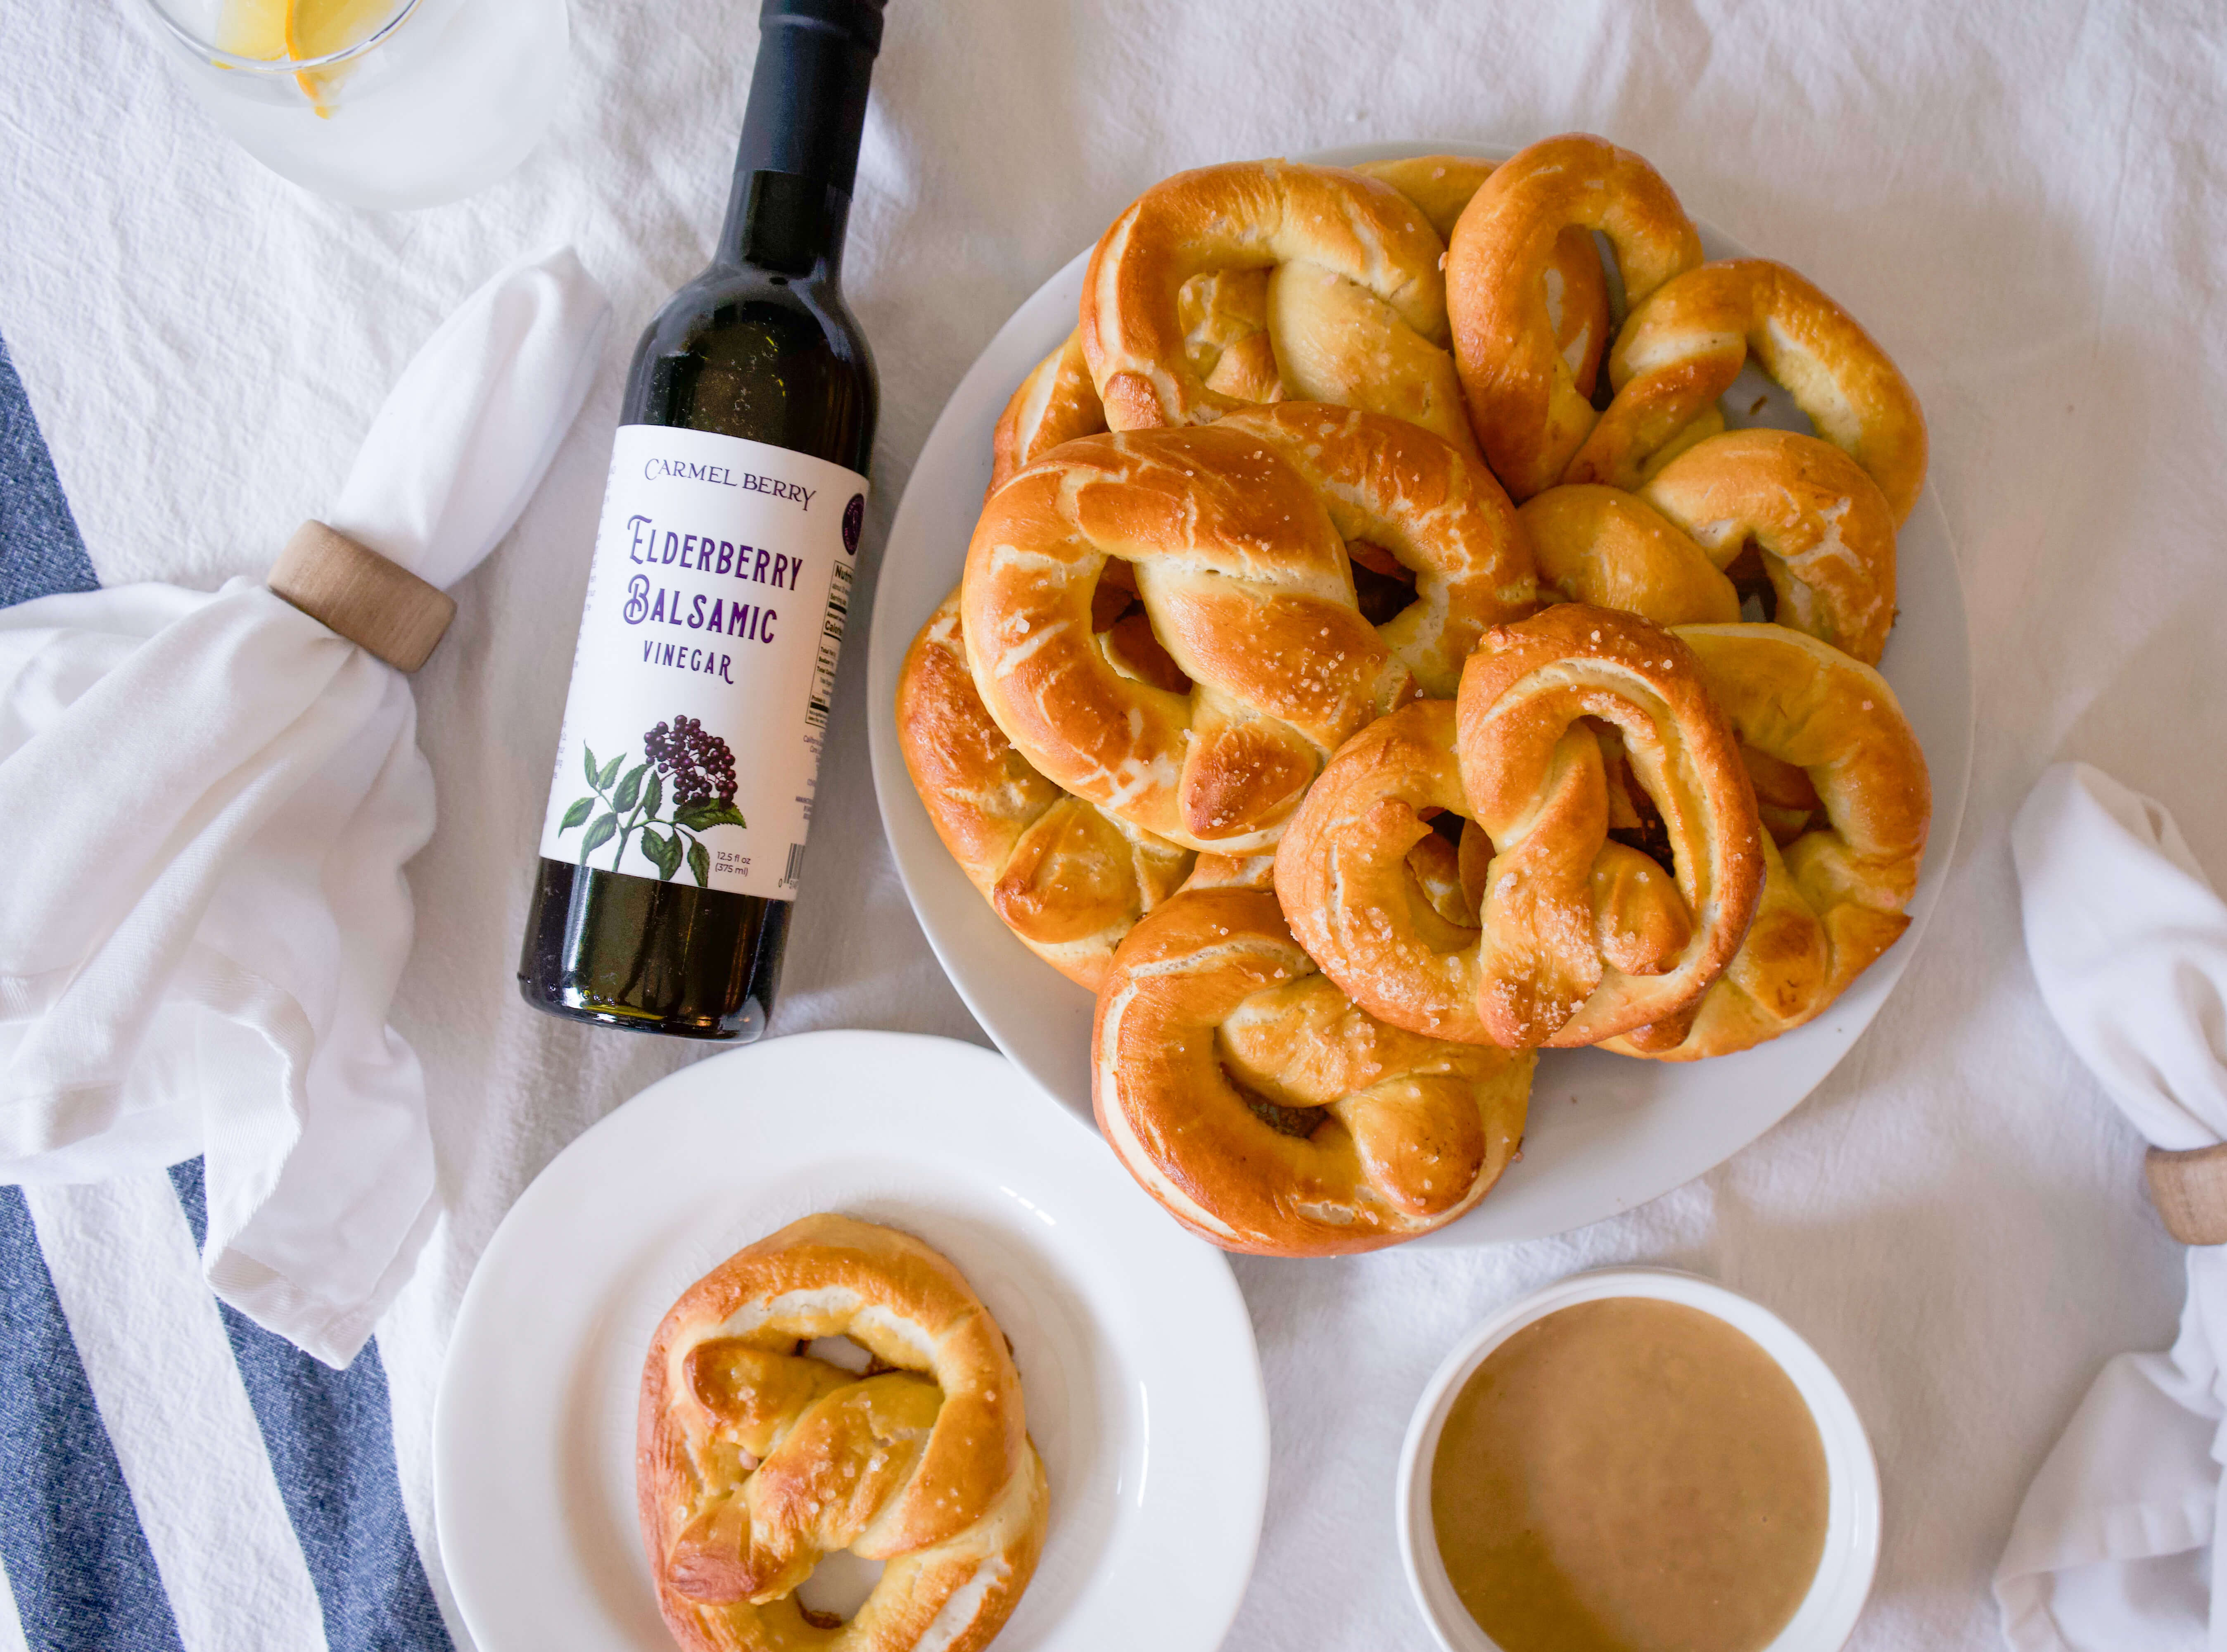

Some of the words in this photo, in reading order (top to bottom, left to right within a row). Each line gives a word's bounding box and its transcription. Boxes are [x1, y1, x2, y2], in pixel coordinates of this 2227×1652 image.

[645, 458, 737, 487] CARMEL
[742, 472, 817, 511] BERRY
[627, 515, 803, 591] ELDERBERRY
[623, 574, 777, 643] BALSAMIC
[644, 640, 734, 685] VINEGAR
[715, 862, 733, 873] (375
[735, 867, 748, 877] ml)
[717, 851, 733, 861] 12.5
